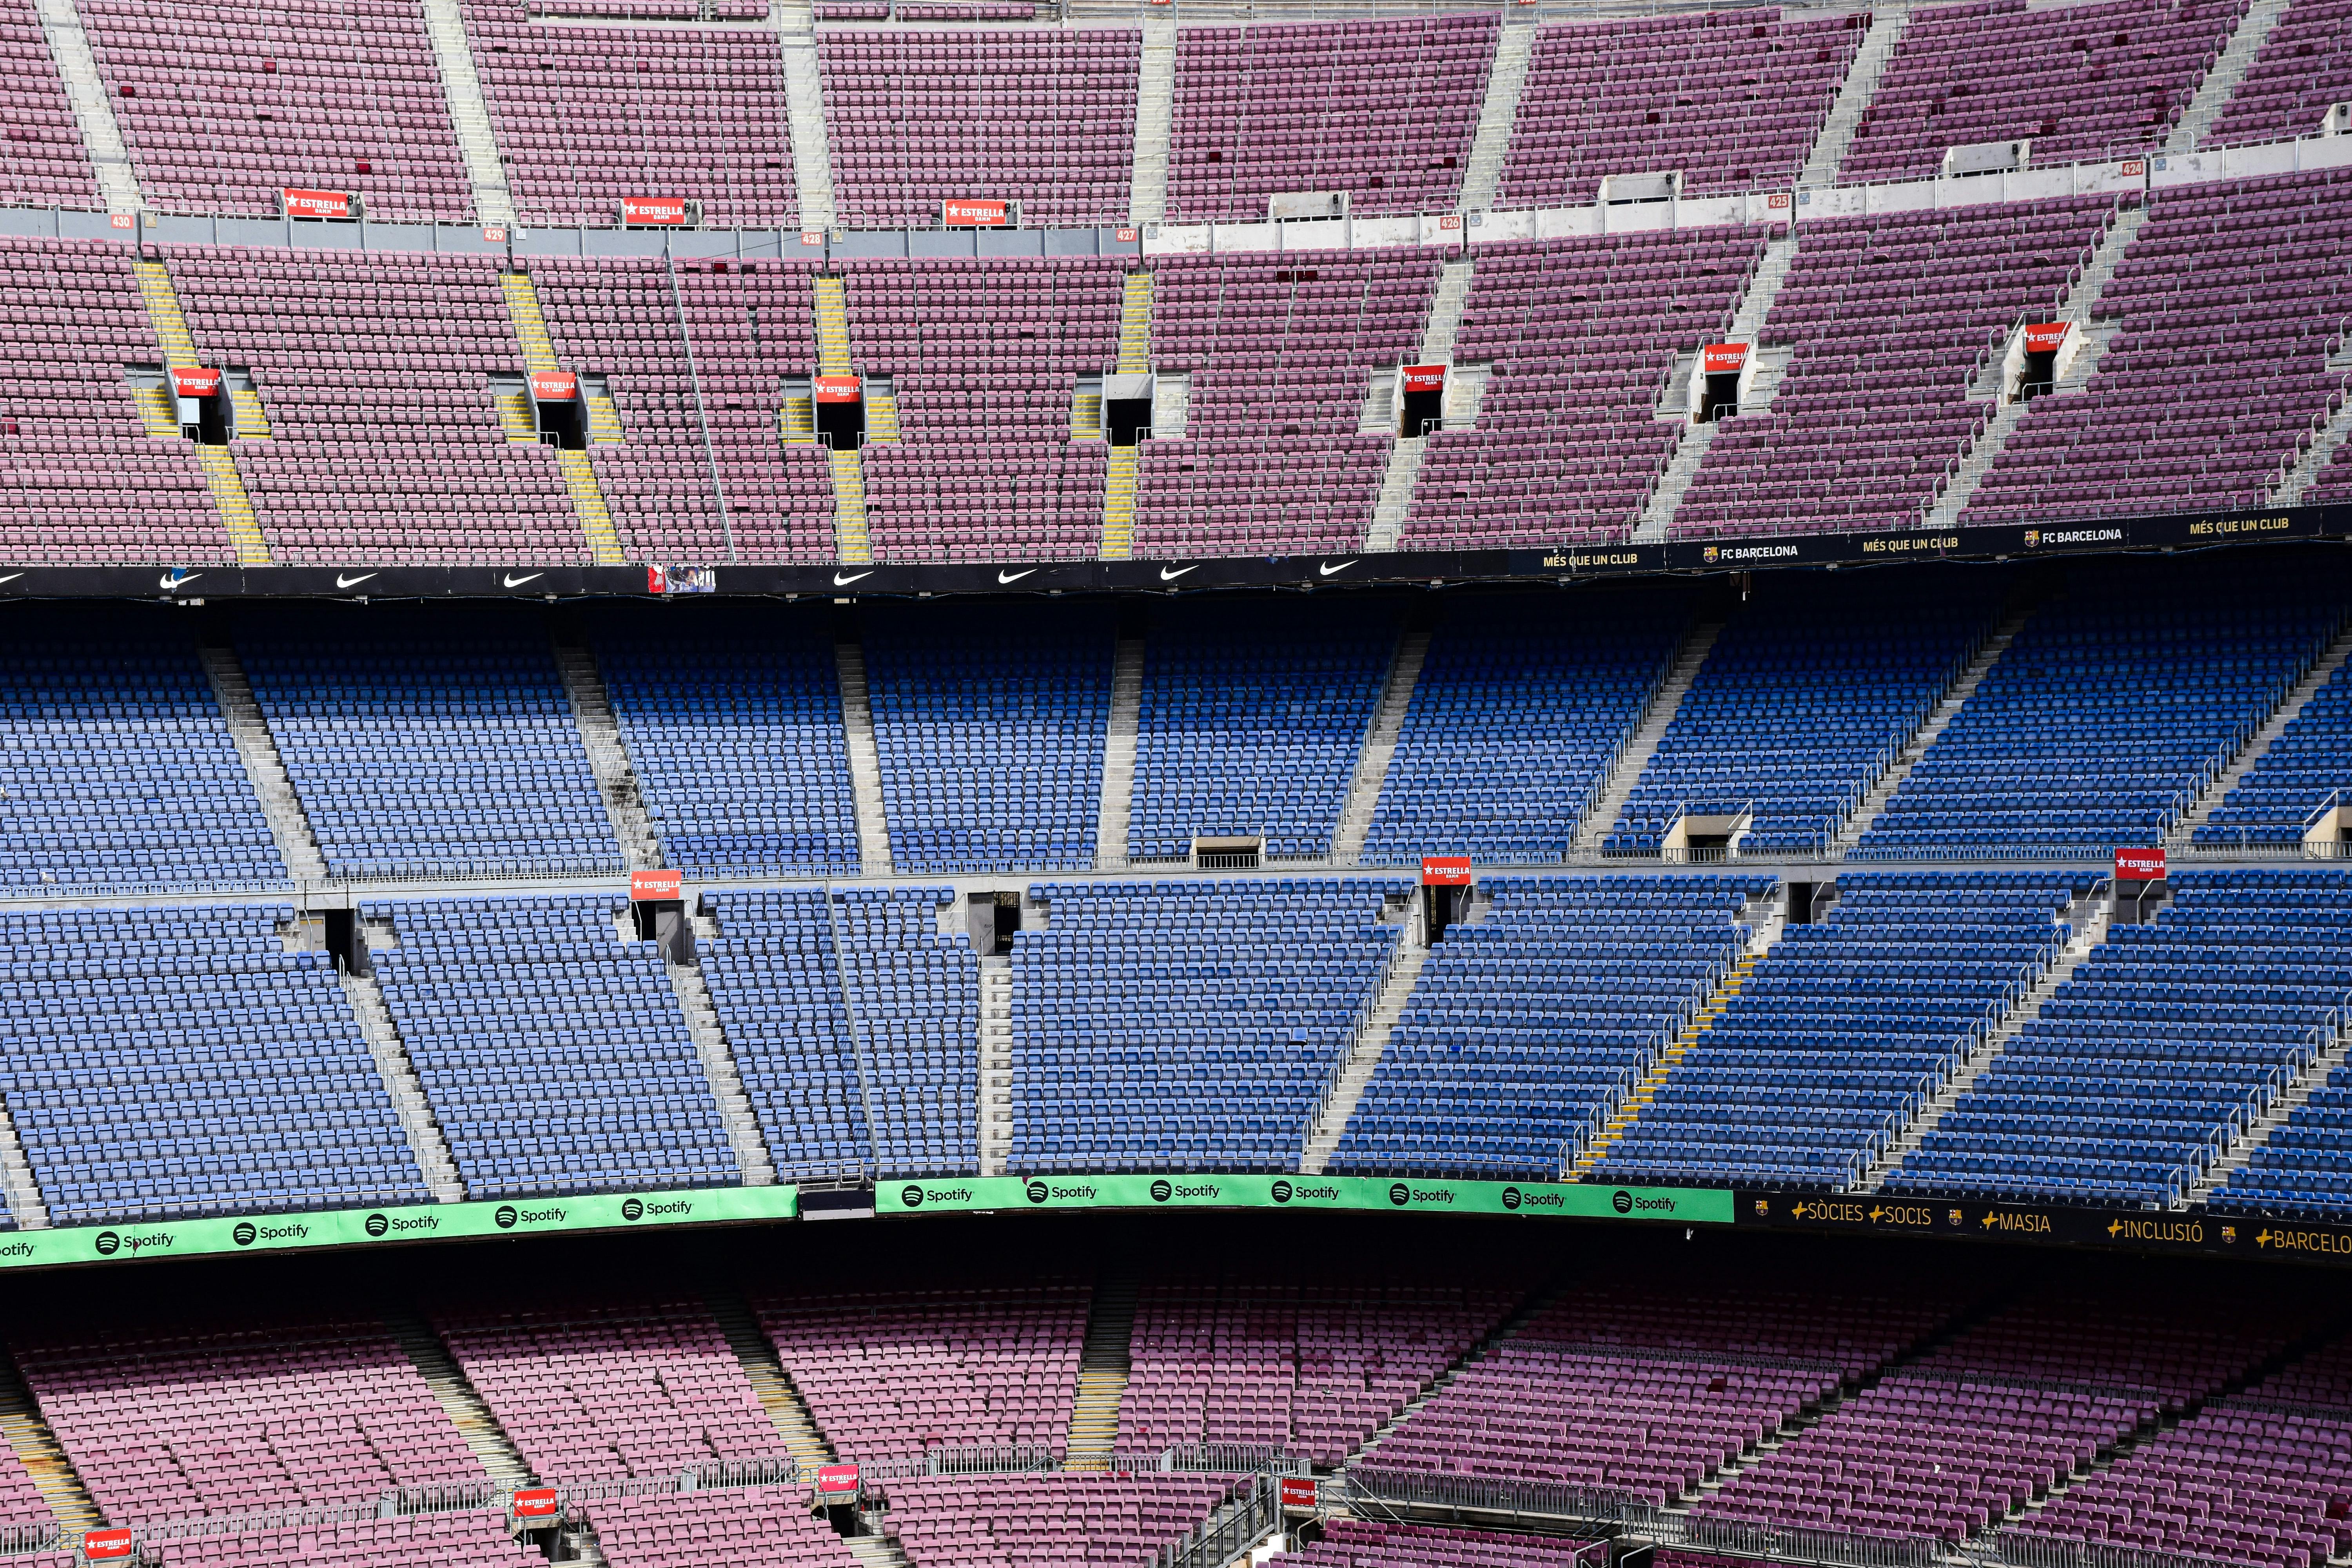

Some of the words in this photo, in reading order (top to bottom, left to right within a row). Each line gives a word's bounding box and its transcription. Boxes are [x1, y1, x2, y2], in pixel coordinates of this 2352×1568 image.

[2124, 163, 2142, 174] 424
[300, 199, 346, 210] ESTRELLA
[1770, 196, 1788, 207] 425
[639, 206, 683, 215] ESTRELLA
[961, 208, 1004, 217] ESTRELLA
[113, 217, 129, 227] 430
[1441, 218, 1459, 228] 426
[485, 229, 504, 240] 429
[803, 234, 820, 244] 428
[1118, 230, 1135, 240] 427
[2190, 520, 2213, 534] MÉS
[2216, 521, 2238, 532] QUE
[2241, 519, 2257, 531] UN
[2260, 518, 2289, 530] CLUB
[2043, 533, 2055, 543] FC
[2057, 528, 2122, 542] BARCELONA
[1864, 538, 1886, 552] MÉS
[1889, 539, 1910, 552] QUE
[1913, 539, 1927, 549] UN
[1930, 537, 1958, 548] CLUB
[1721, 549, 1733, 559] FC
[1735, 545, 1798, 558] BARCELONA
[1544, 554, 1566, 567] MÉS
[1569, 555, 1590, 566] QUE
[1593, 555, 1608, 565] UN
[1610, 554, 1637, 564] CLUB
[927, 1188, 972, 1203] Spotify
[1052, 1185, 1097, 1199] Spotify
[1175, 1185, 1220, 1198] Spotify
[1296, 1186, 1339, 1200] Spotify
[1413, 1189, 1454, 1203] Spotify
[1524, 1193, 1564, 1207] Spotify
[1635, 1197, 1675, 1212] Spotify
[521, 1208, 566, 1223] Spotify
[647, 1201, 692, 1216] Spotify
[392, 1216, 439, 1231] Spotify
[260, 1224, 309, 1240] Spotify
[124, 1233, 174, 1250] Spotify
[0, 1243, 34, 1257] otify
[97, 1539, 129, 1548] ESTRELLA
